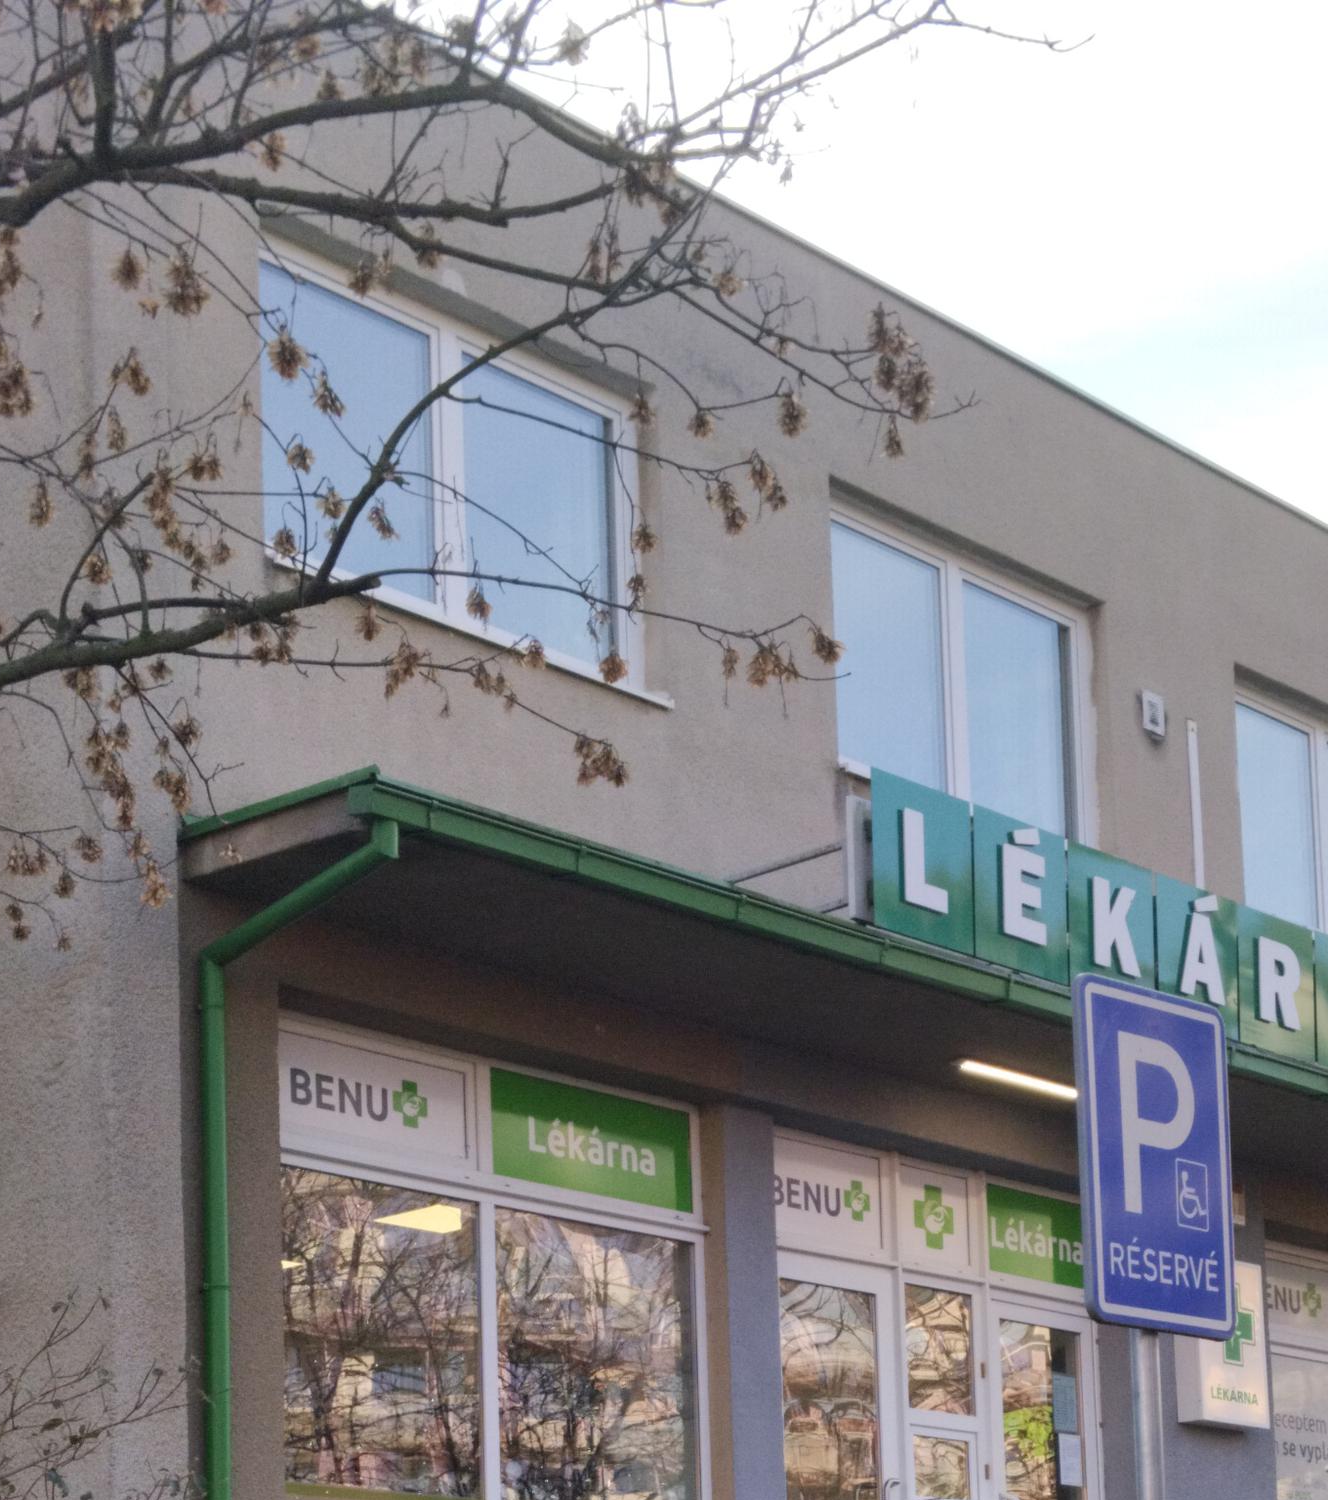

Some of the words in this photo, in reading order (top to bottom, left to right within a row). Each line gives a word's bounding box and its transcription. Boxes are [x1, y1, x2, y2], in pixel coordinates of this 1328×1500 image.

[289, 1067, 388, 1122] BENU
[527, 1116, 656, 1177] Lékárna
[1118, 1030, 1195, 1214] P
[990, 1216, 1083, 1265] Lékárna
[1110, 1237, 1219, 1292] RÉSERVÉ
[1263, 1283, 1301, 1315] ENU
[1210, 1384, 1259, 1406] LÉKÁRNA
[1282, 1441, 1296, 1457] se
